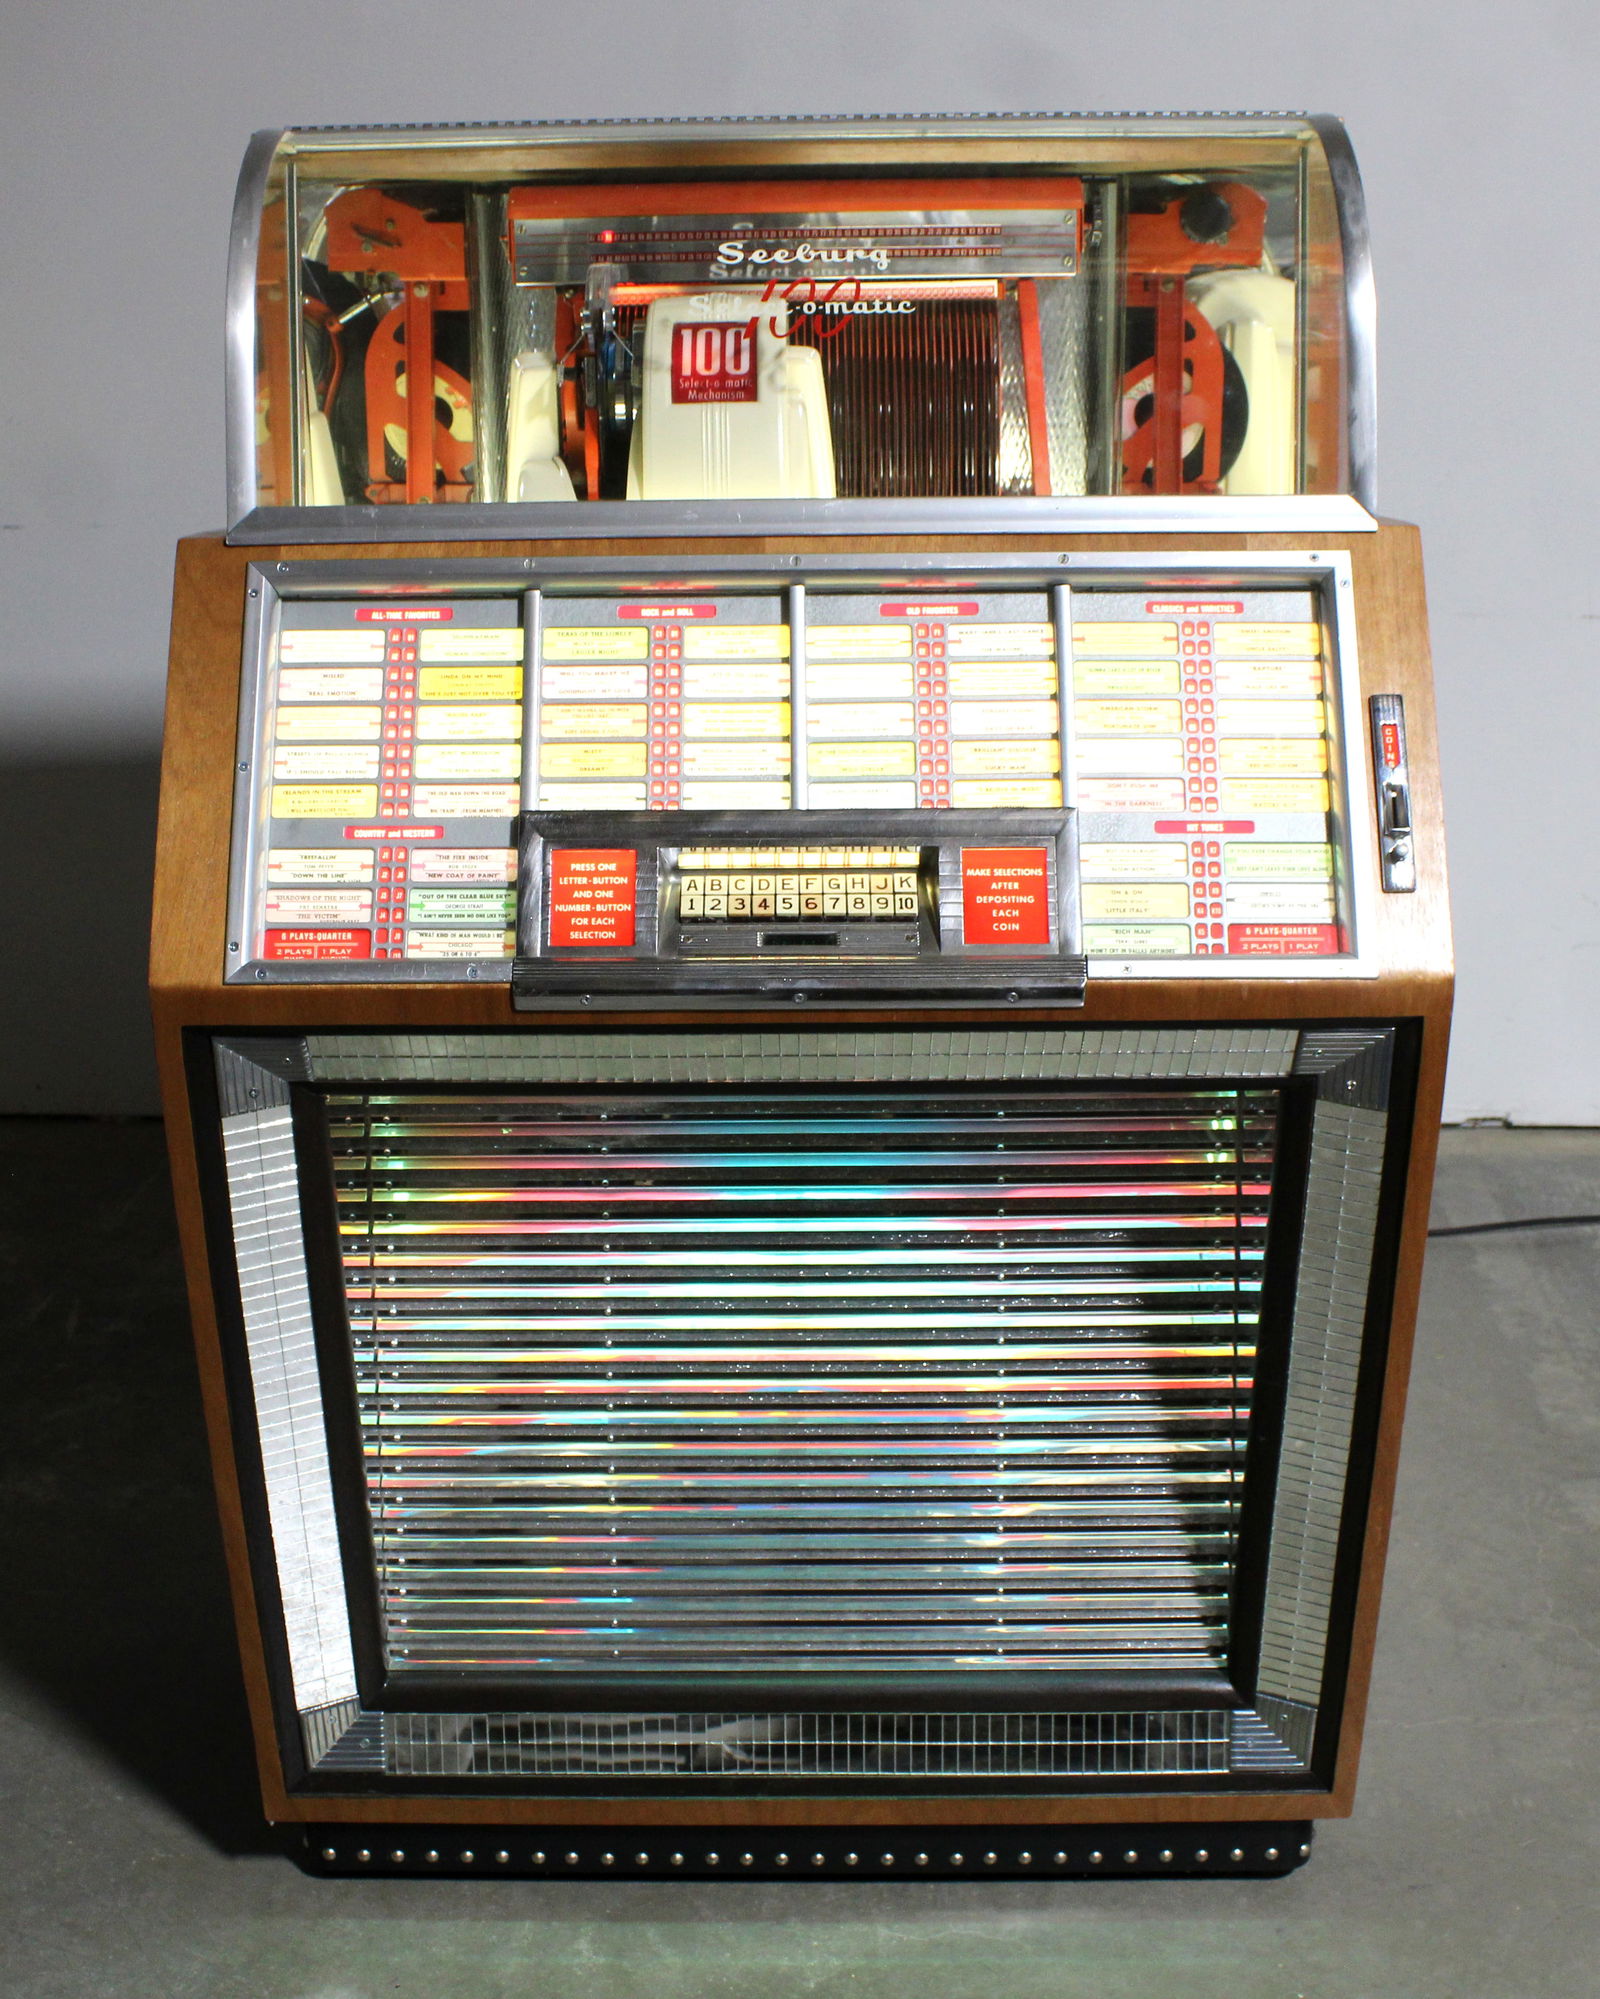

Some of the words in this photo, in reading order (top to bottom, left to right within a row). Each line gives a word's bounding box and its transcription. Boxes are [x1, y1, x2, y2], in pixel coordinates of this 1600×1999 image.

[716, 241, 891, 270] Seeburg
[680, 328, 751, 376] 100
[688, 389, 745, 400] Mechanism
[661, 608, 675, 616] and
[906, 606, 920, 615] OLD
[388, 829, 401, 838] and
[570, 864, 596, 872] PRESS
[598, 864, 616, 872] ONE
[966, 868, 991, 876] MAKE
[994, 868, 1044, 876] SELECTIONS
[686, 879, 699, 892] A
[710, 879, 722, 892] B
[734, 878, 746, 892] C
[758, 878, 771, 891] D
[781, 878, 794, 891] E
[805, 878, 818, 891] F
[828, 878, 841, 891] G
[852, 877, 865, 890] H
[876, 878, 889, 891] J
[899, 875, 912, 889] K
[991, 882, 1020, 890] AFTER
[573, 890, 592, 898] AND
[594, 890, 614, 898] ONE
[687, 898, 696, 912] 1
[709, 898, 722, 912] 2
[733, 897, 746, 911] 3
[757, 897, 770, 911] 4
[781, 897, 793, 910] 5
[804, 896, 818, 910] 6
[828, 897, 841, 910] 7
[852, 897, 865, 910] 8
[876, 896, 890, 910] 9
[898, 896, 914, 910] 10
[976, 896, 1035, 904] DEPOSITING
[992, 909, 1020, 917] EACH
[571, 918, 588, 926] FOR
[591, 918, 614, 926] EACH
[992, 923, 1020, 931] COIN
[570, 931, 616, 939] SELECTION
[1254, 927, 1318, 936] PLAYS-QUARTER
[290, 932, 352, 941] PLAYS-QUARTER
